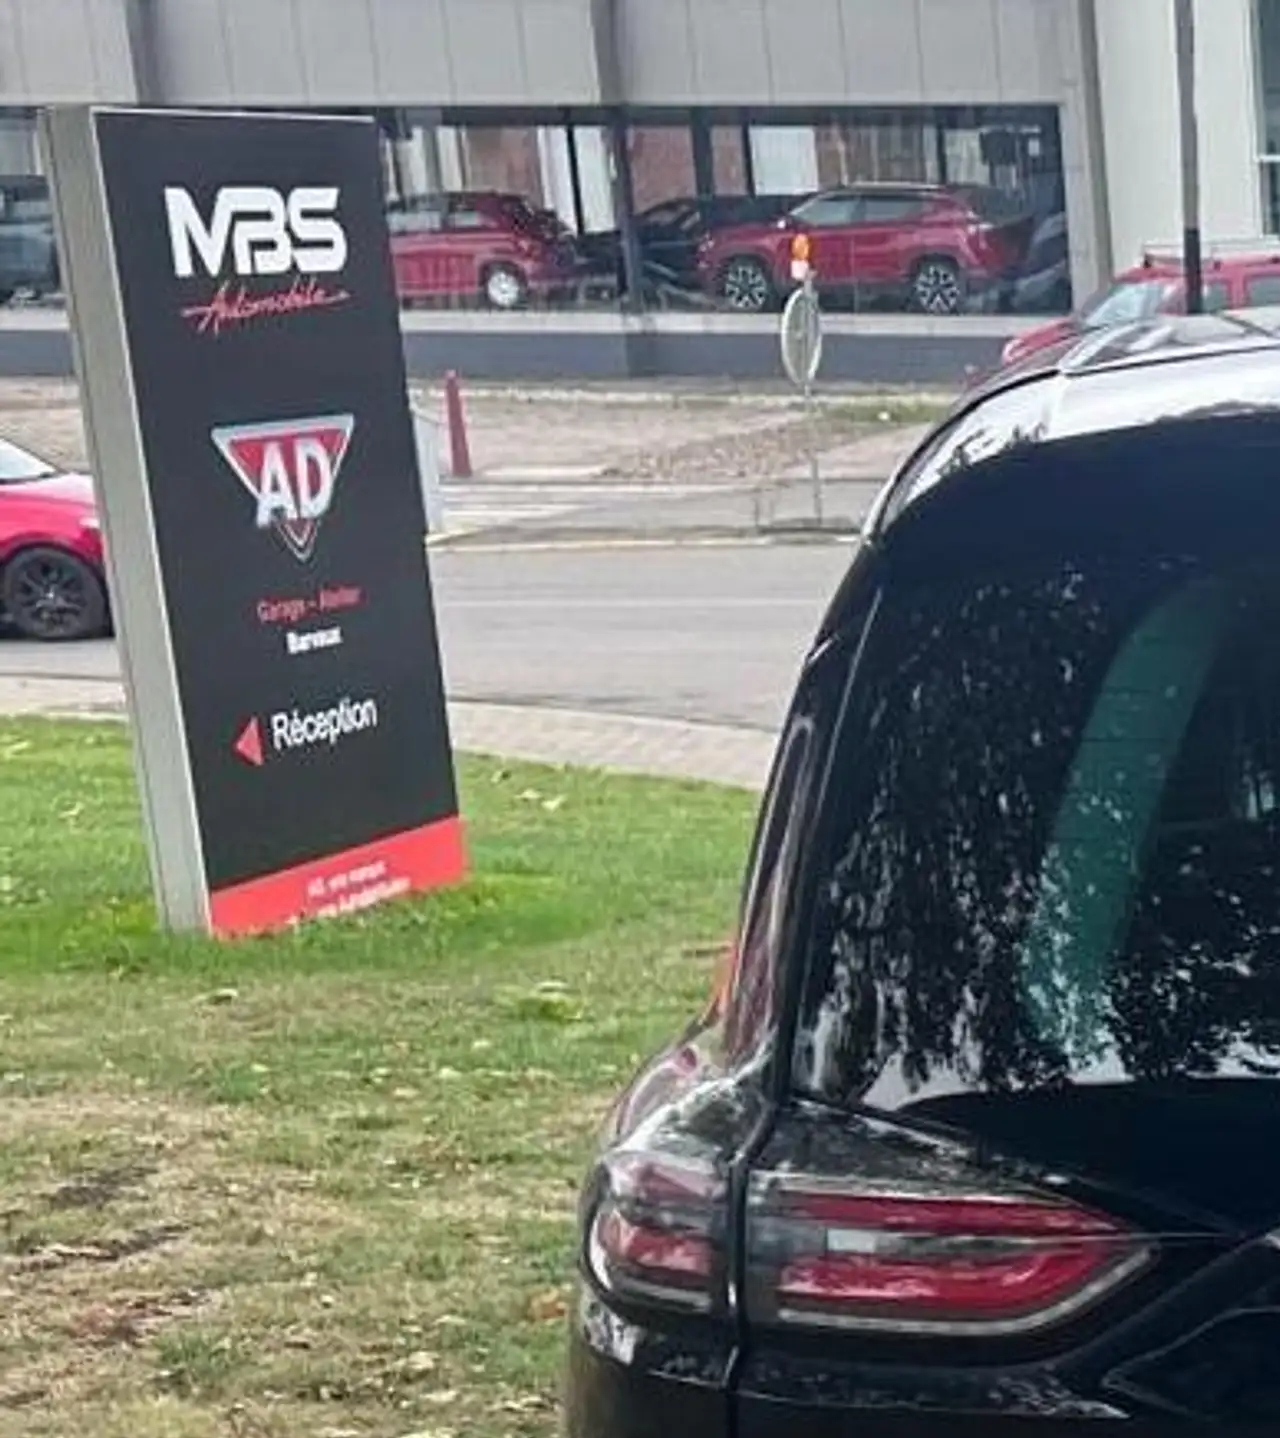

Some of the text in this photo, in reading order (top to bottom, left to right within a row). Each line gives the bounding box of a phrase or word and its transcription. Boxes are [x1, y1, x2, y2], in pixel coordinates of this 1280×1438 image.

[164, 186, 348, 278] MBS
[255, 437, 334, 529] AD
[271, 697, 379, 751] Réception
